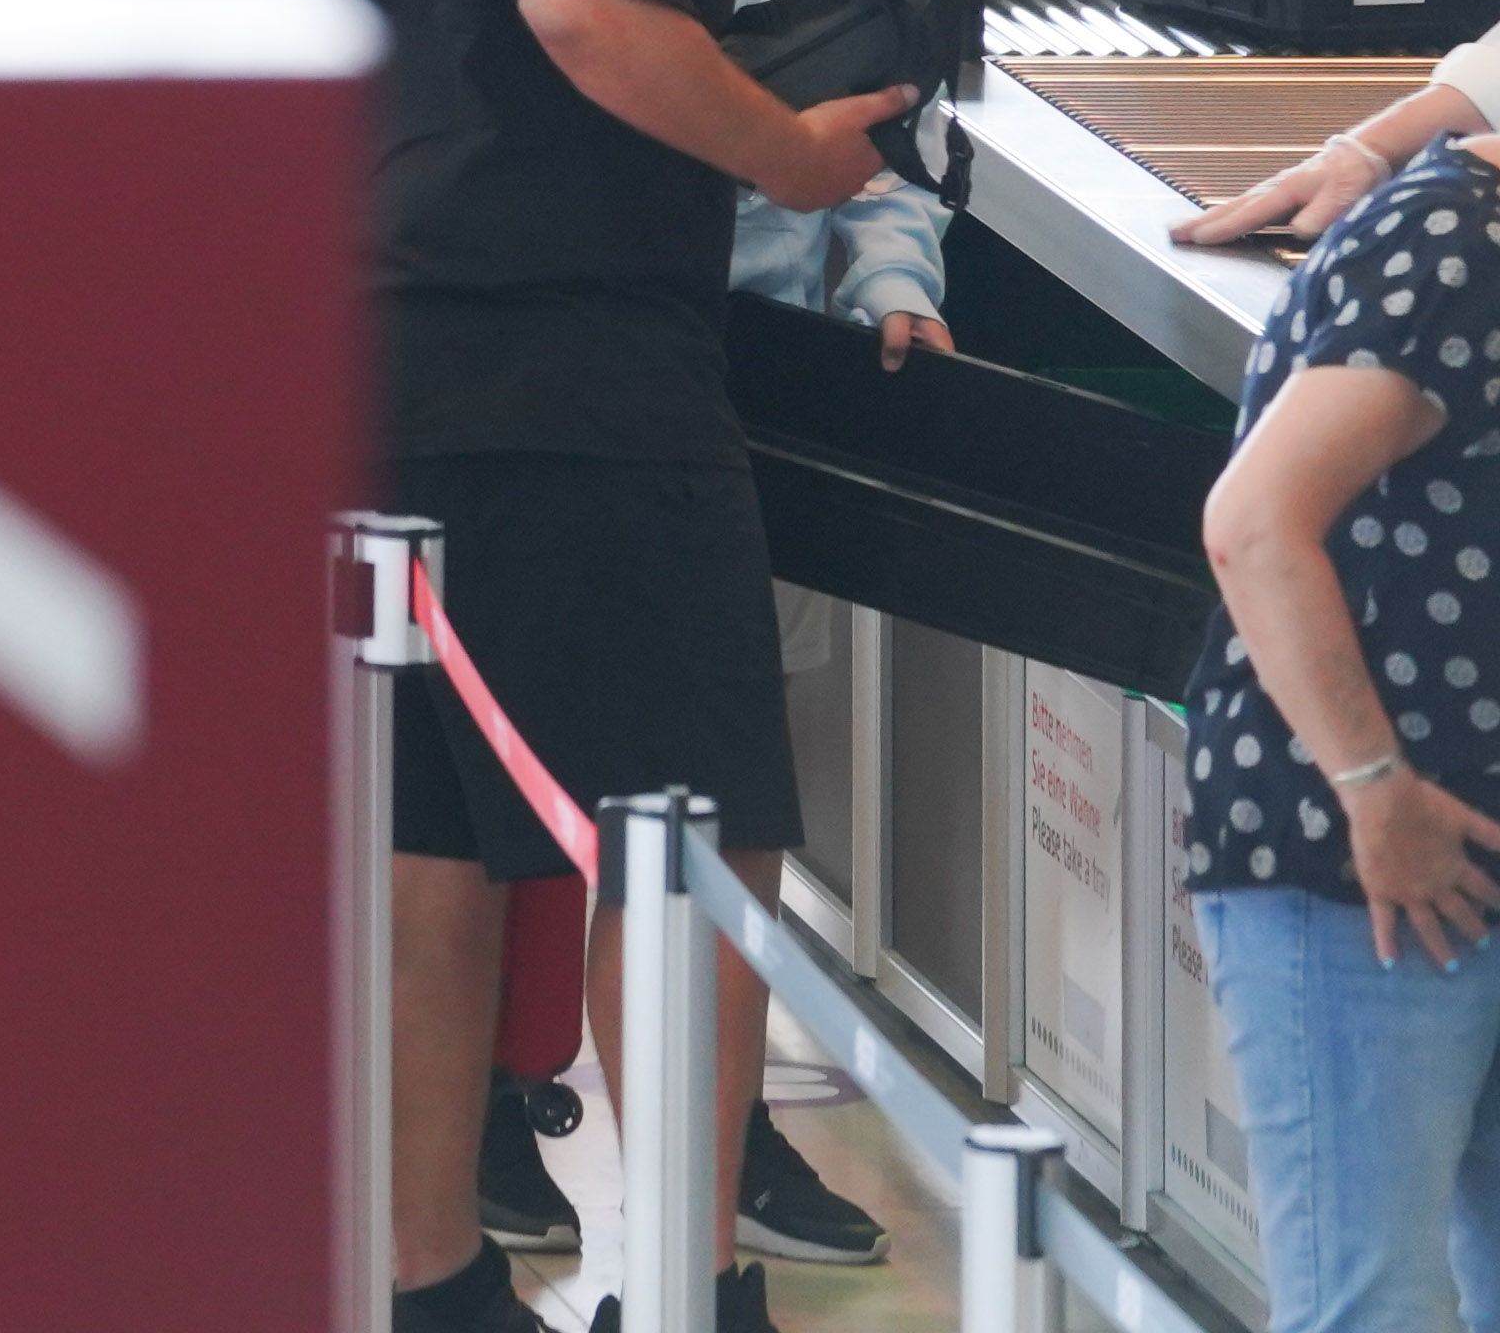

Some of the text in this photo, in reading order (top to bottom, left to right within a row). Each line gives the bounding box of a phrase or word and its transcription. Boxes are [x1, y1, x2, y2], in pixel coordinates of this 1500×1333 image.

[1031, 691, 1094, 775] Bitte nehmen
[1031, 747, 1102, 838] Sie eine Wanne
[1031, 805, 1063, 864] Please
[1062, 829, 1084, 883] take
[1172, 925, 1203, 985] Please
